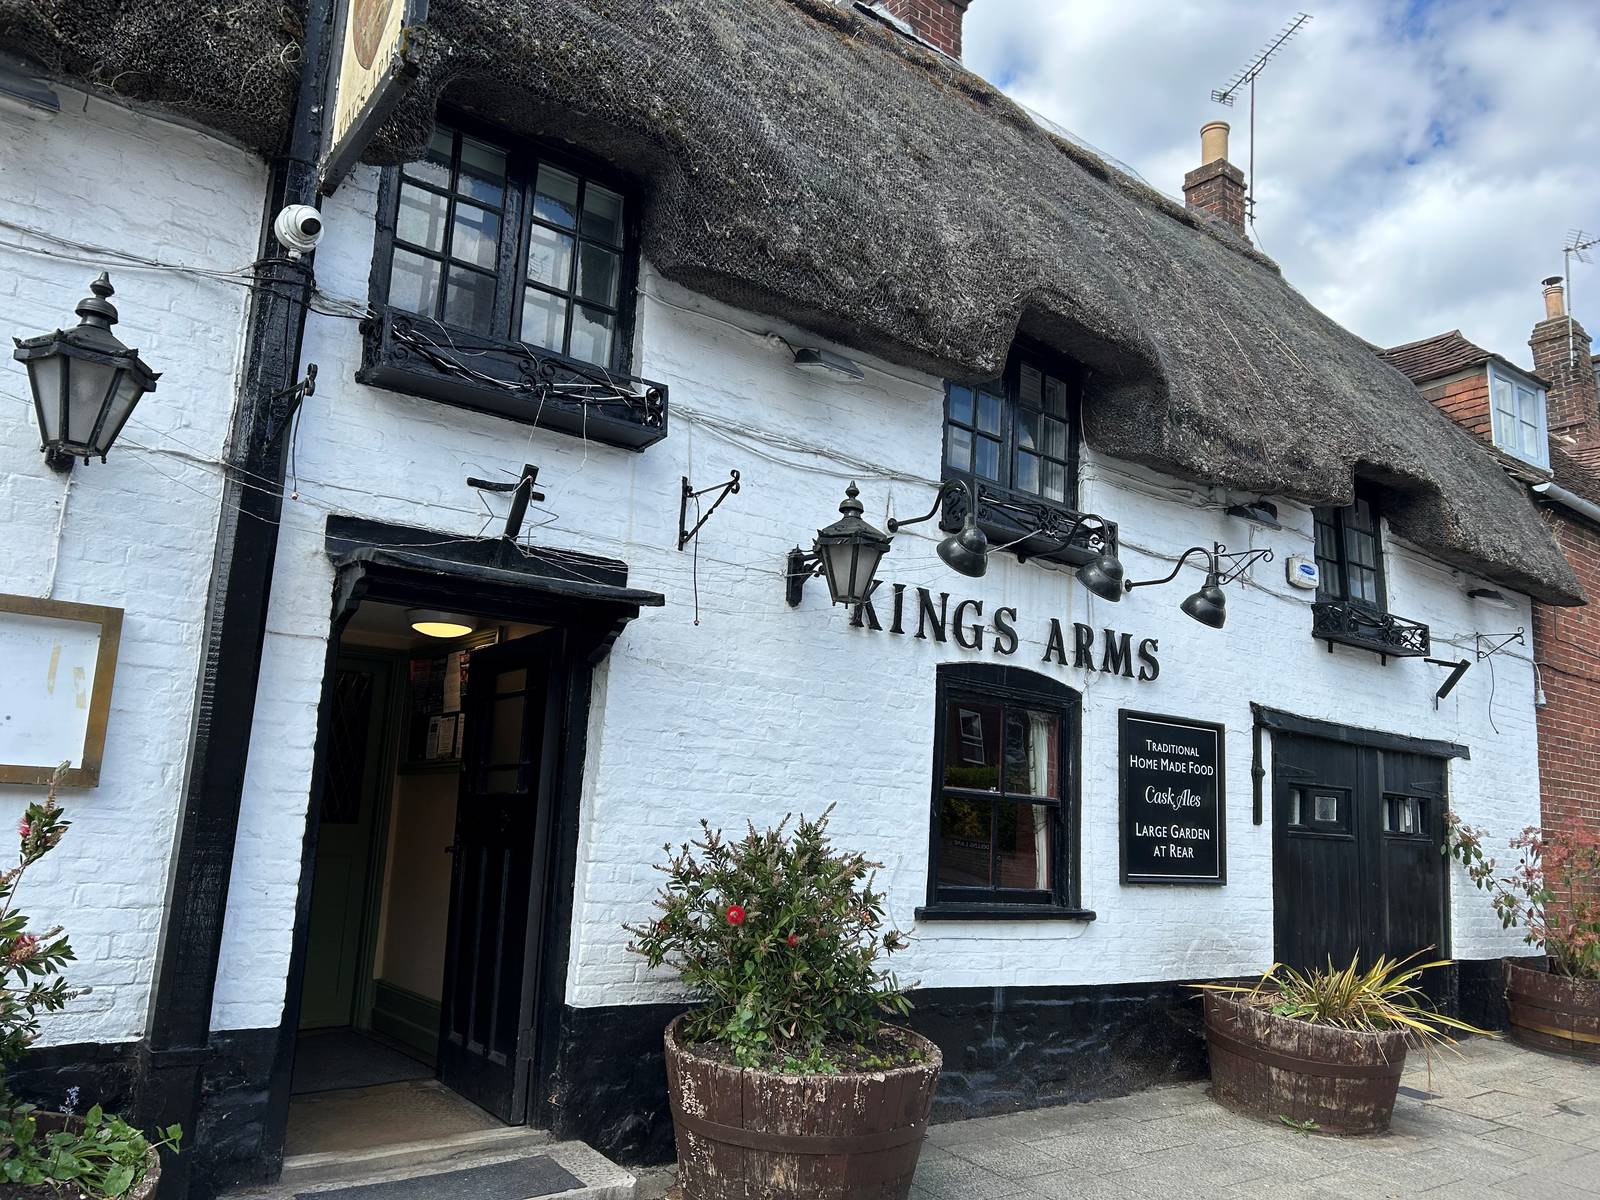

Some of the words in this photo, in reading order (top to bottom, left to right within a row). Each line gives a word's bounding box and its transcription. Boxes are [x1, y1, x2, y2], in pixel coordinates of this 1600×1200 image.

[849, 579, 1019, 656] KINGS
[1041, 617, 1160, 682] ARMS
[1145, 739, 1200, 758] TRADITIONAL
[1130, 754, 1158, 771] HOME
[1160, 758, 1187, 774] MADE
[1188, 761, 1214, 776] FOOD
[1145, 785, 1175, 807] Cask
[1173, 788, 1201, 811] Ales
[1135, 822, 1168, 838] LARGE
[1170, 824, 1210, 840] GARDEN
[1153, 845, 1167, 858] AT
[1169, 843, 1195, 859] REAR
